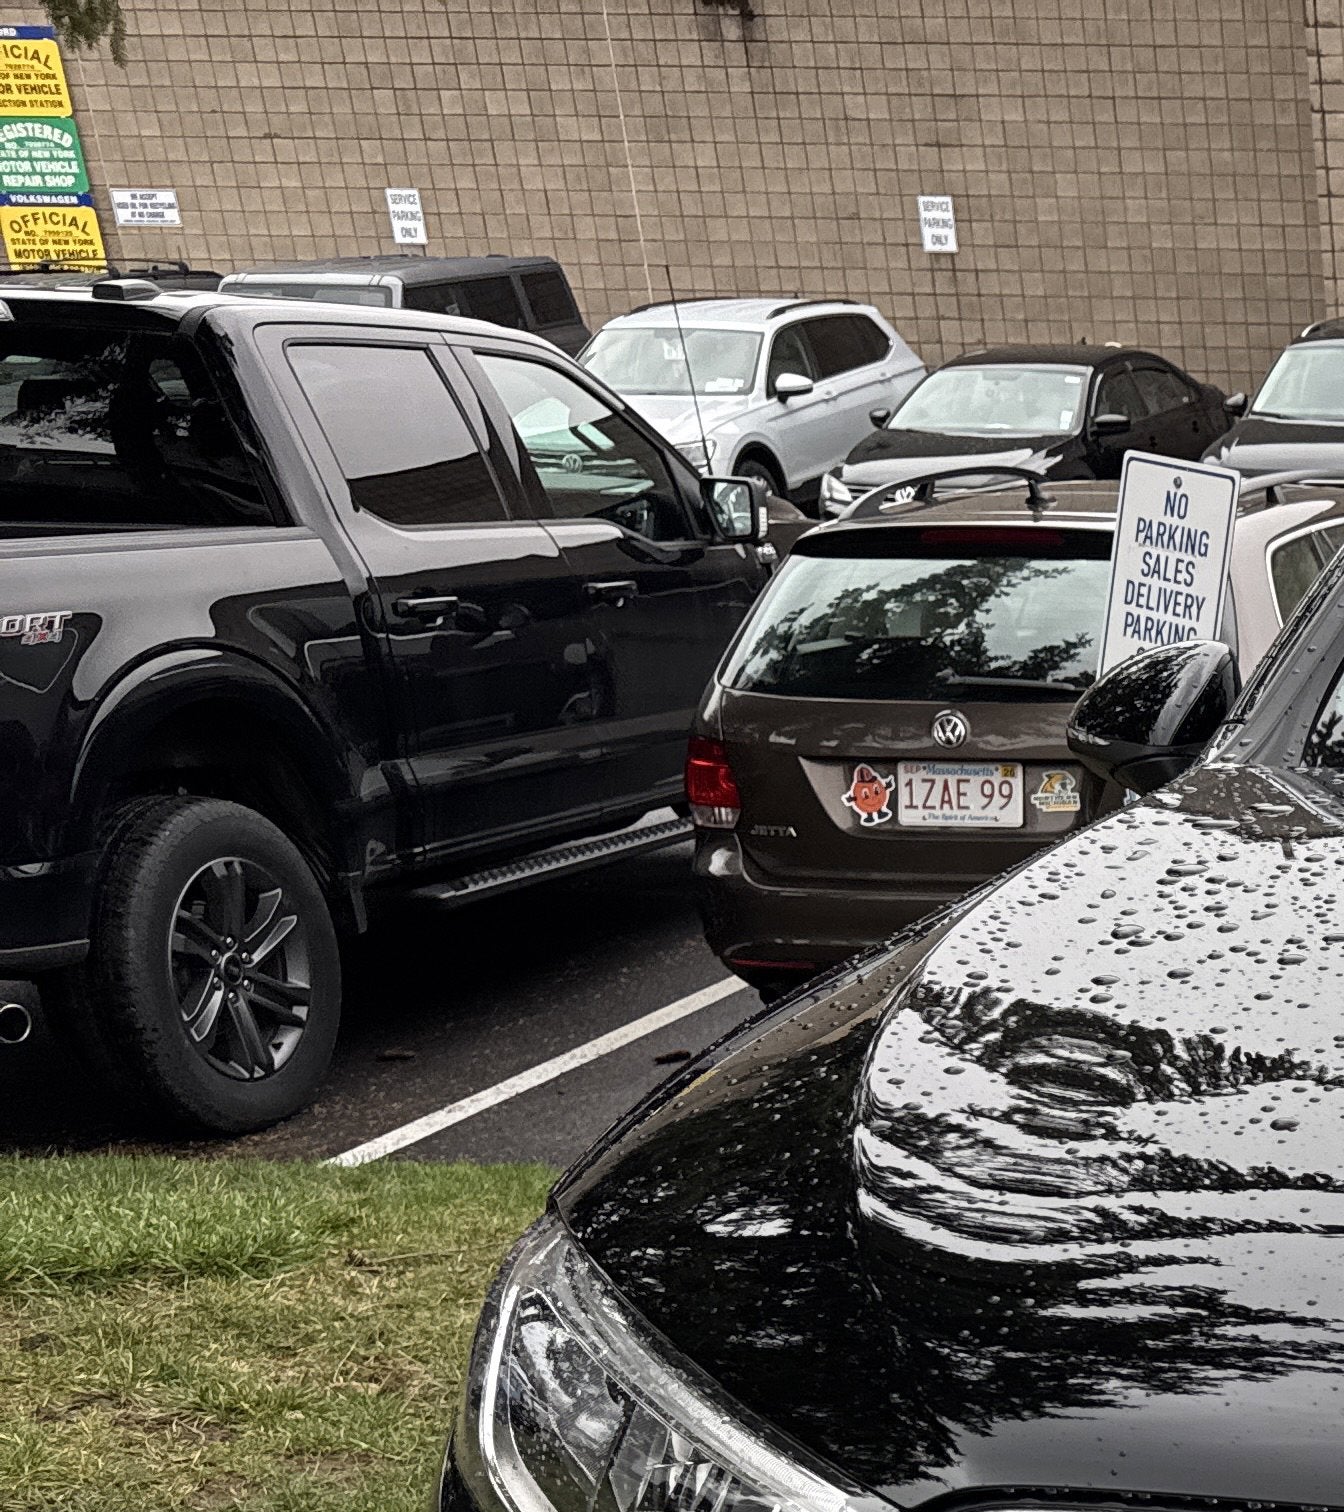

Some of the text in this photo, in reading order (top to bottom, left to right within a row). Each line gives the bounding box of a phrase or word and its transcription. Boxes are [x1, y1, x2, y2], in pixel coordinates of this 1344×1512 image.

[0, 44, 52, 70] ICIAL
[15, 84, 62, 95] VEHICLE
[29, 100, 64, 108] STATION
[31, 150, 50, 158] NEW
[33, 161, 79, 173] VEHICLE
[2, 175, 75, 187] REPAIR SHOP
[9, 194, 78, 204] VOLKSWAGEN
[10, 211, 90, 236] OFFICIAL
[14, 248, 98, 260] MOTOR VEHICLE
[1163, 490, 1189, 520] NO
[1135, 516, 1210, 558] PARKING
[1141, 551, 1196, 588] SALES
[1124, 579, 1206, 622] DELIVERY
[926, 764, 994, 777] Massachusetts
[904, 778, 971, 810] 1ZAE
[980, 779, 1014, 810] 99
